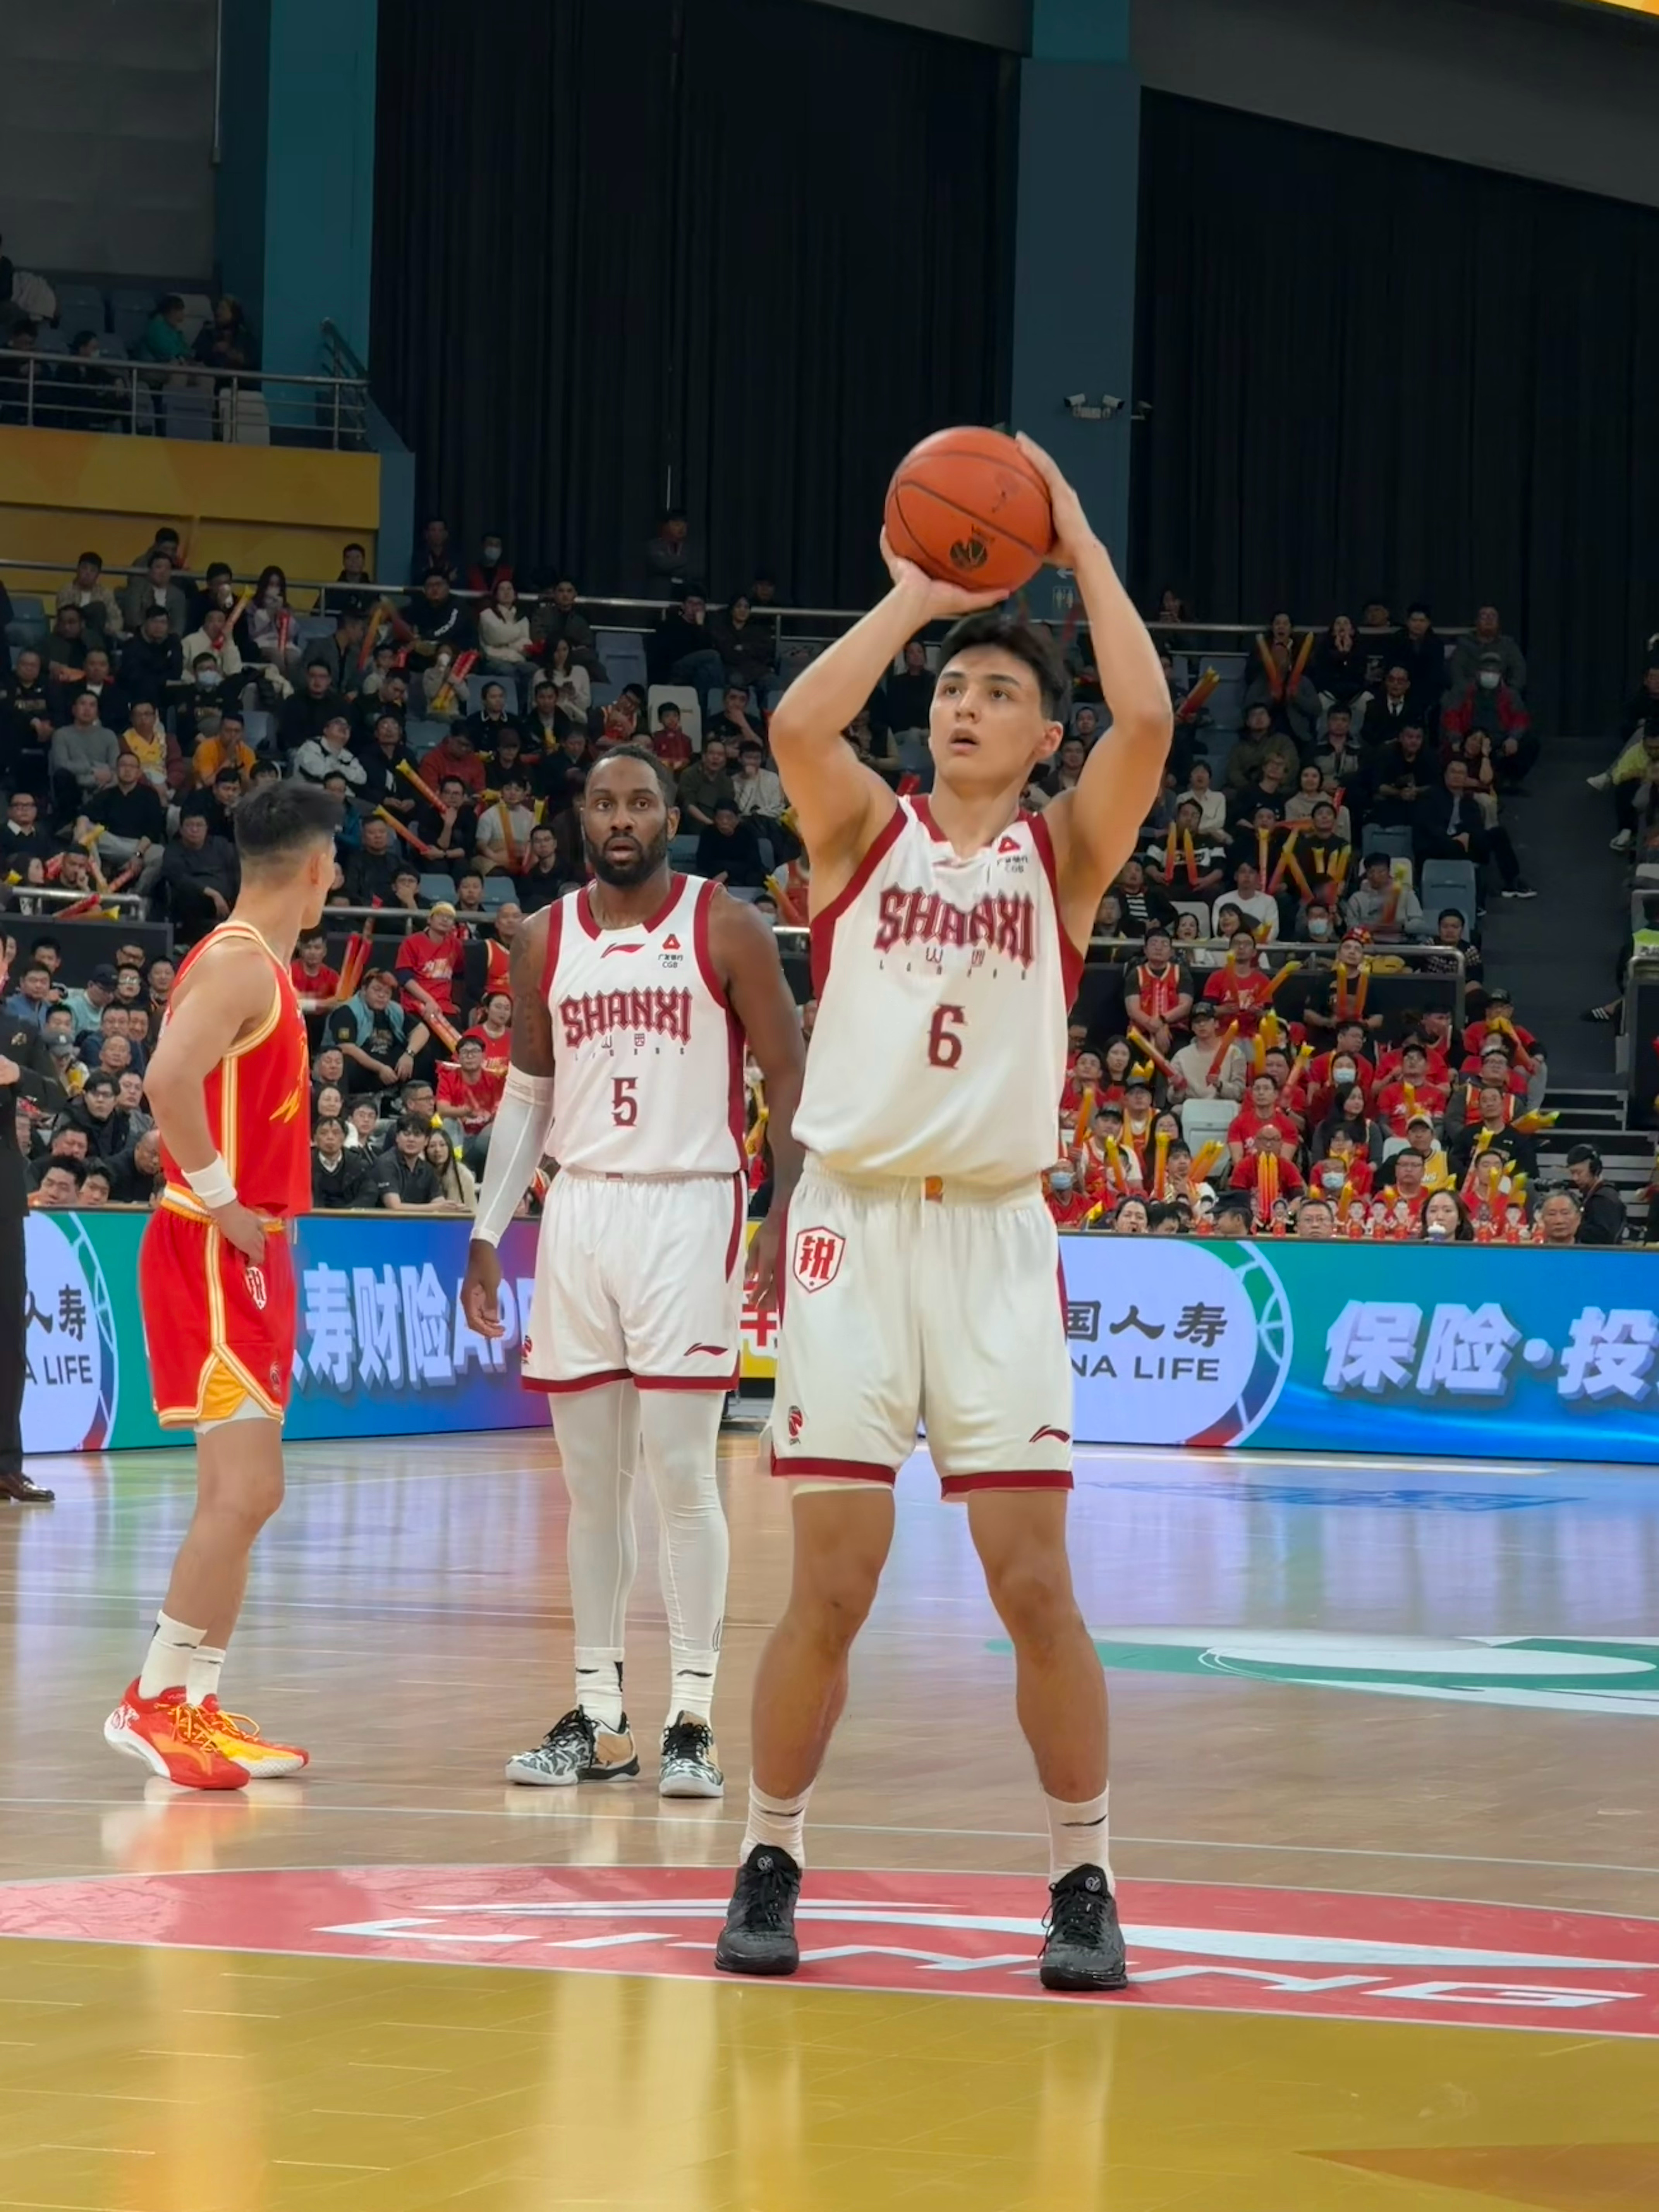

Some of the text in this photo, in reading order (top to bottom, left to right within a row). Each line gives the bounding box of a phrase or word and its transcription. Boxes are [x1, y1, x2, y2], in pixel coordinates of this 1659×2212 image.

[874, 881, 1034, 969] SHANXI
[559, 986, 693, 1049] SHANXI
[927, 1002, 969, 1070] 6
[611, 1076, 639, 1127] 5
[43, 1355, 93, 1385] LIFE
[1134, 1356, 1220, 1381] LIFE
[1322, 1299, 1659, 1403] 保险·投
